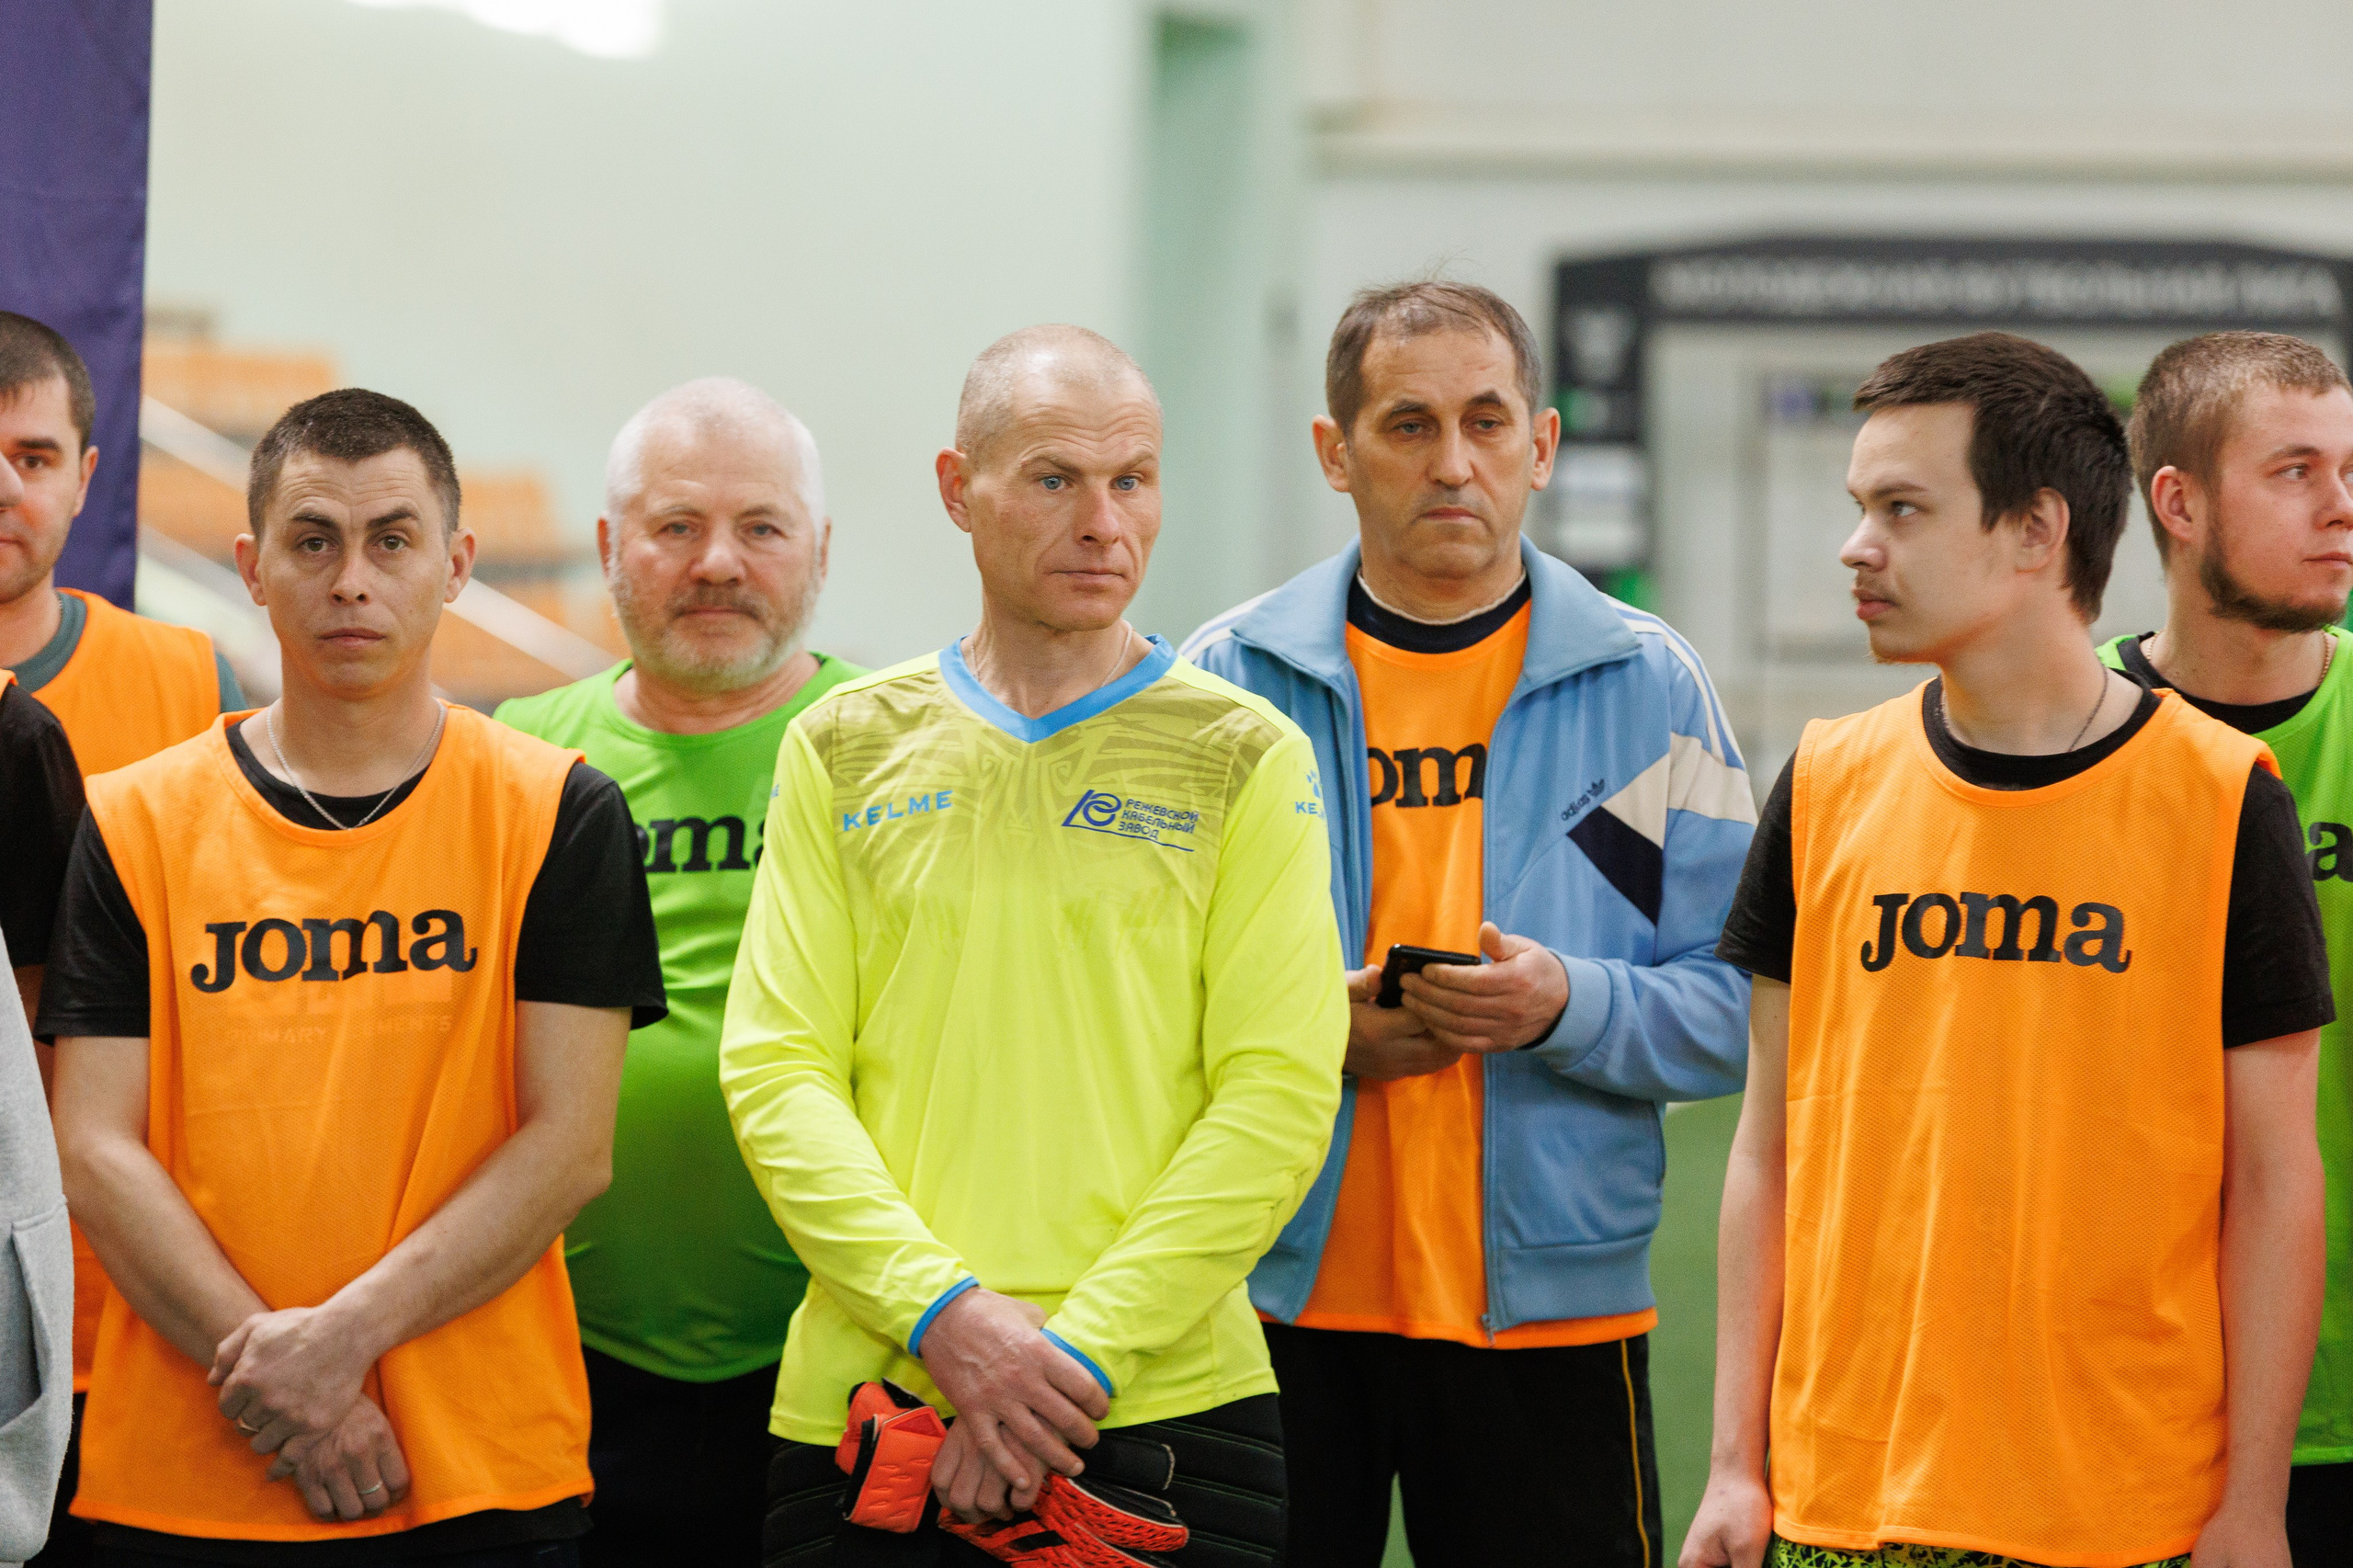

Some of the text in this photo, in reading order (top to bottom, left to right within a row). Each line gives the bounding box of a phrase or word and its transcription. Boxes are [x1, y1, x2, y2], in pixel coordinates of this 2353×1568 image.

[1368, 743, 1487, 808] om
[842, 790, 953, 832] KELME
[1121, 809, 1196, 835] КАБЕЛЬНЫЙ
[1126, 798, 1199, 823] РЕЖЕВСКОЙ
[1118, 821, 1160, 841] ЗАВОД
